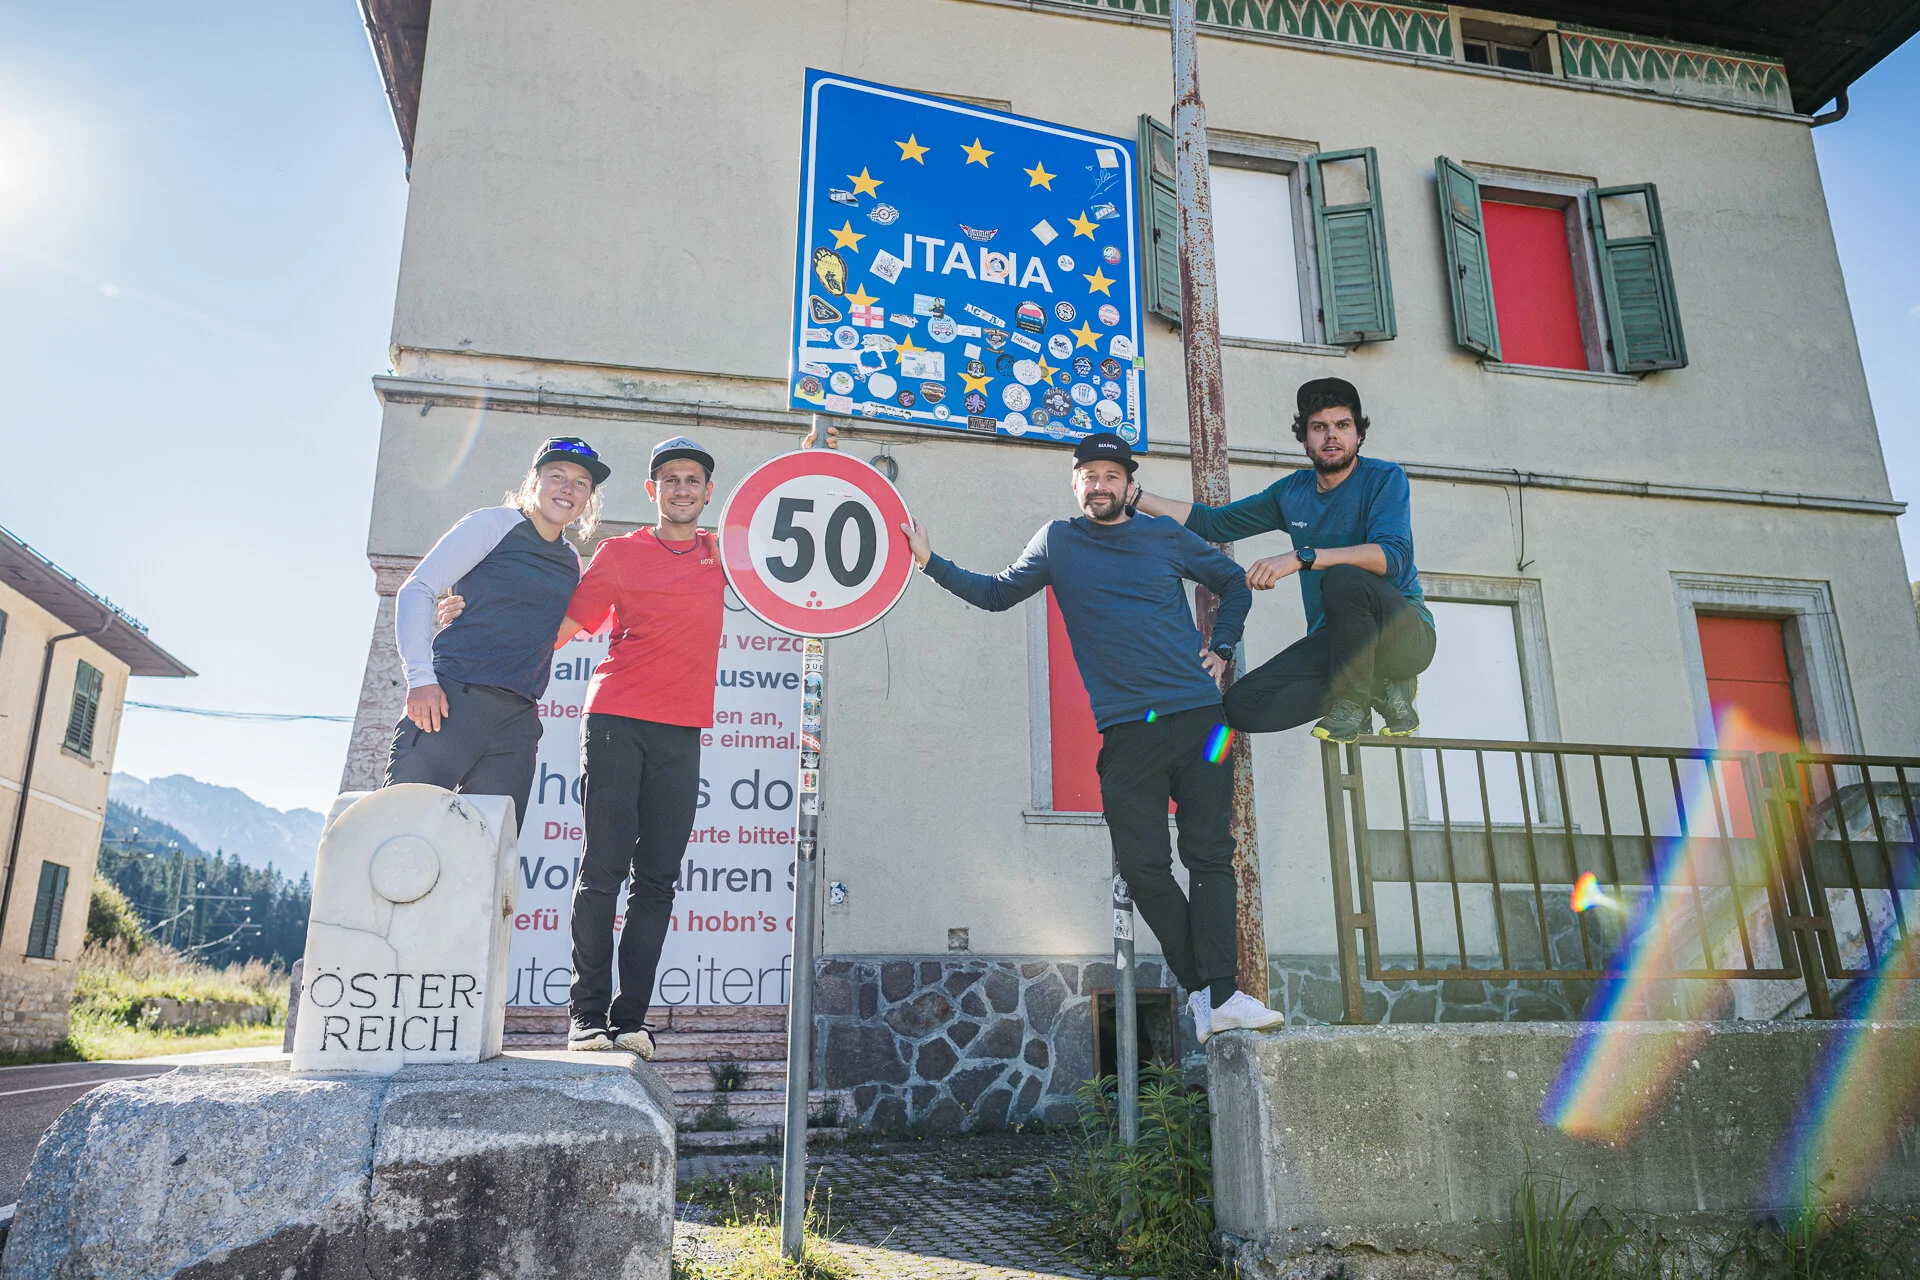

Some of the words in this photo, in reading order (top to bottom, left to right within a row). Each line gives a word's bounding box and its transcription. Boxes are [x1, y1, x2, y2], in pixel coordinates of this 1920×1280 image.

[904, 233, 1053, 293] ITALIA
[765, 497, 877, 588] 50
[736, 634, 804, 653] verzo
[554, 657, 598, 681] all
[714, 669, 800, 690] uswe
[537, 699, 584, 719] abe
[750, 711, 783, 729] an,
[720, 730, 800, 750] einmal.
[688, 826, 731, 844] arte
[738, 825, 796, 845] bitte!
[673, 859, 772, 893] hren
[514, 908, 559, 931] efü
[310, 966, 483, 1009] ÖSTER-
[505, 956, 573, 1006] ute
[658, 954, 792, 1005] eiterf
[319, 1015, 459, 1052] REICH
